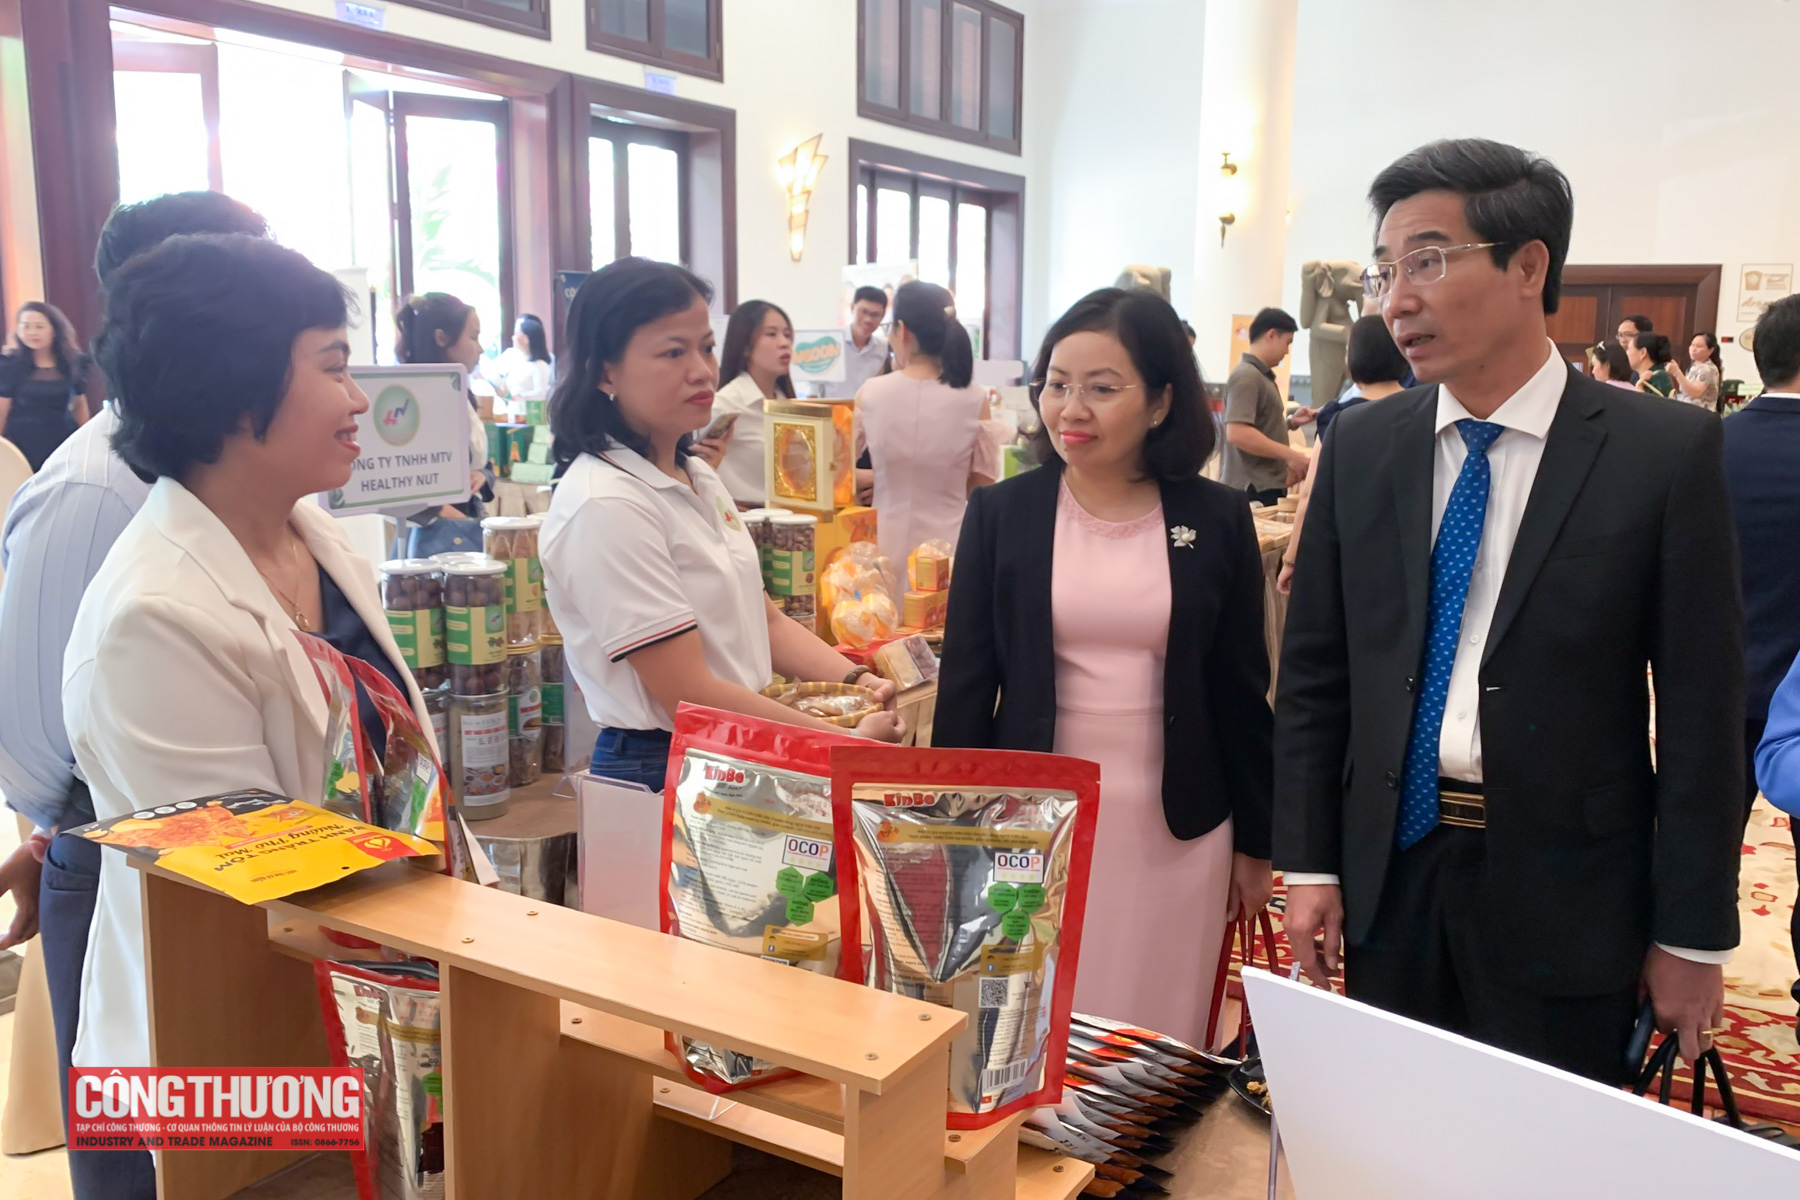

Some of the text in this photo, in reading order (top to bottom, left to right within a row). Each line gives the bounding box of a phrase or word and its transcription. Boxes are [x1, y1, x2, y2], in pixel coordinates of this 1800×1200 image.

[377, 455, 392, 469] TY
[395, 453, 428, 468] TNHH
[430, 451, 453, 465] MTV
[361, 472, 439, 493] HEALTHY NUT
[320, 826, 367, 840] BÁNH
[788, 838, 830, 857] OCOP
[213, 854, 260, 872] TÔM
[997, 854, 1041, 869] OCOP
